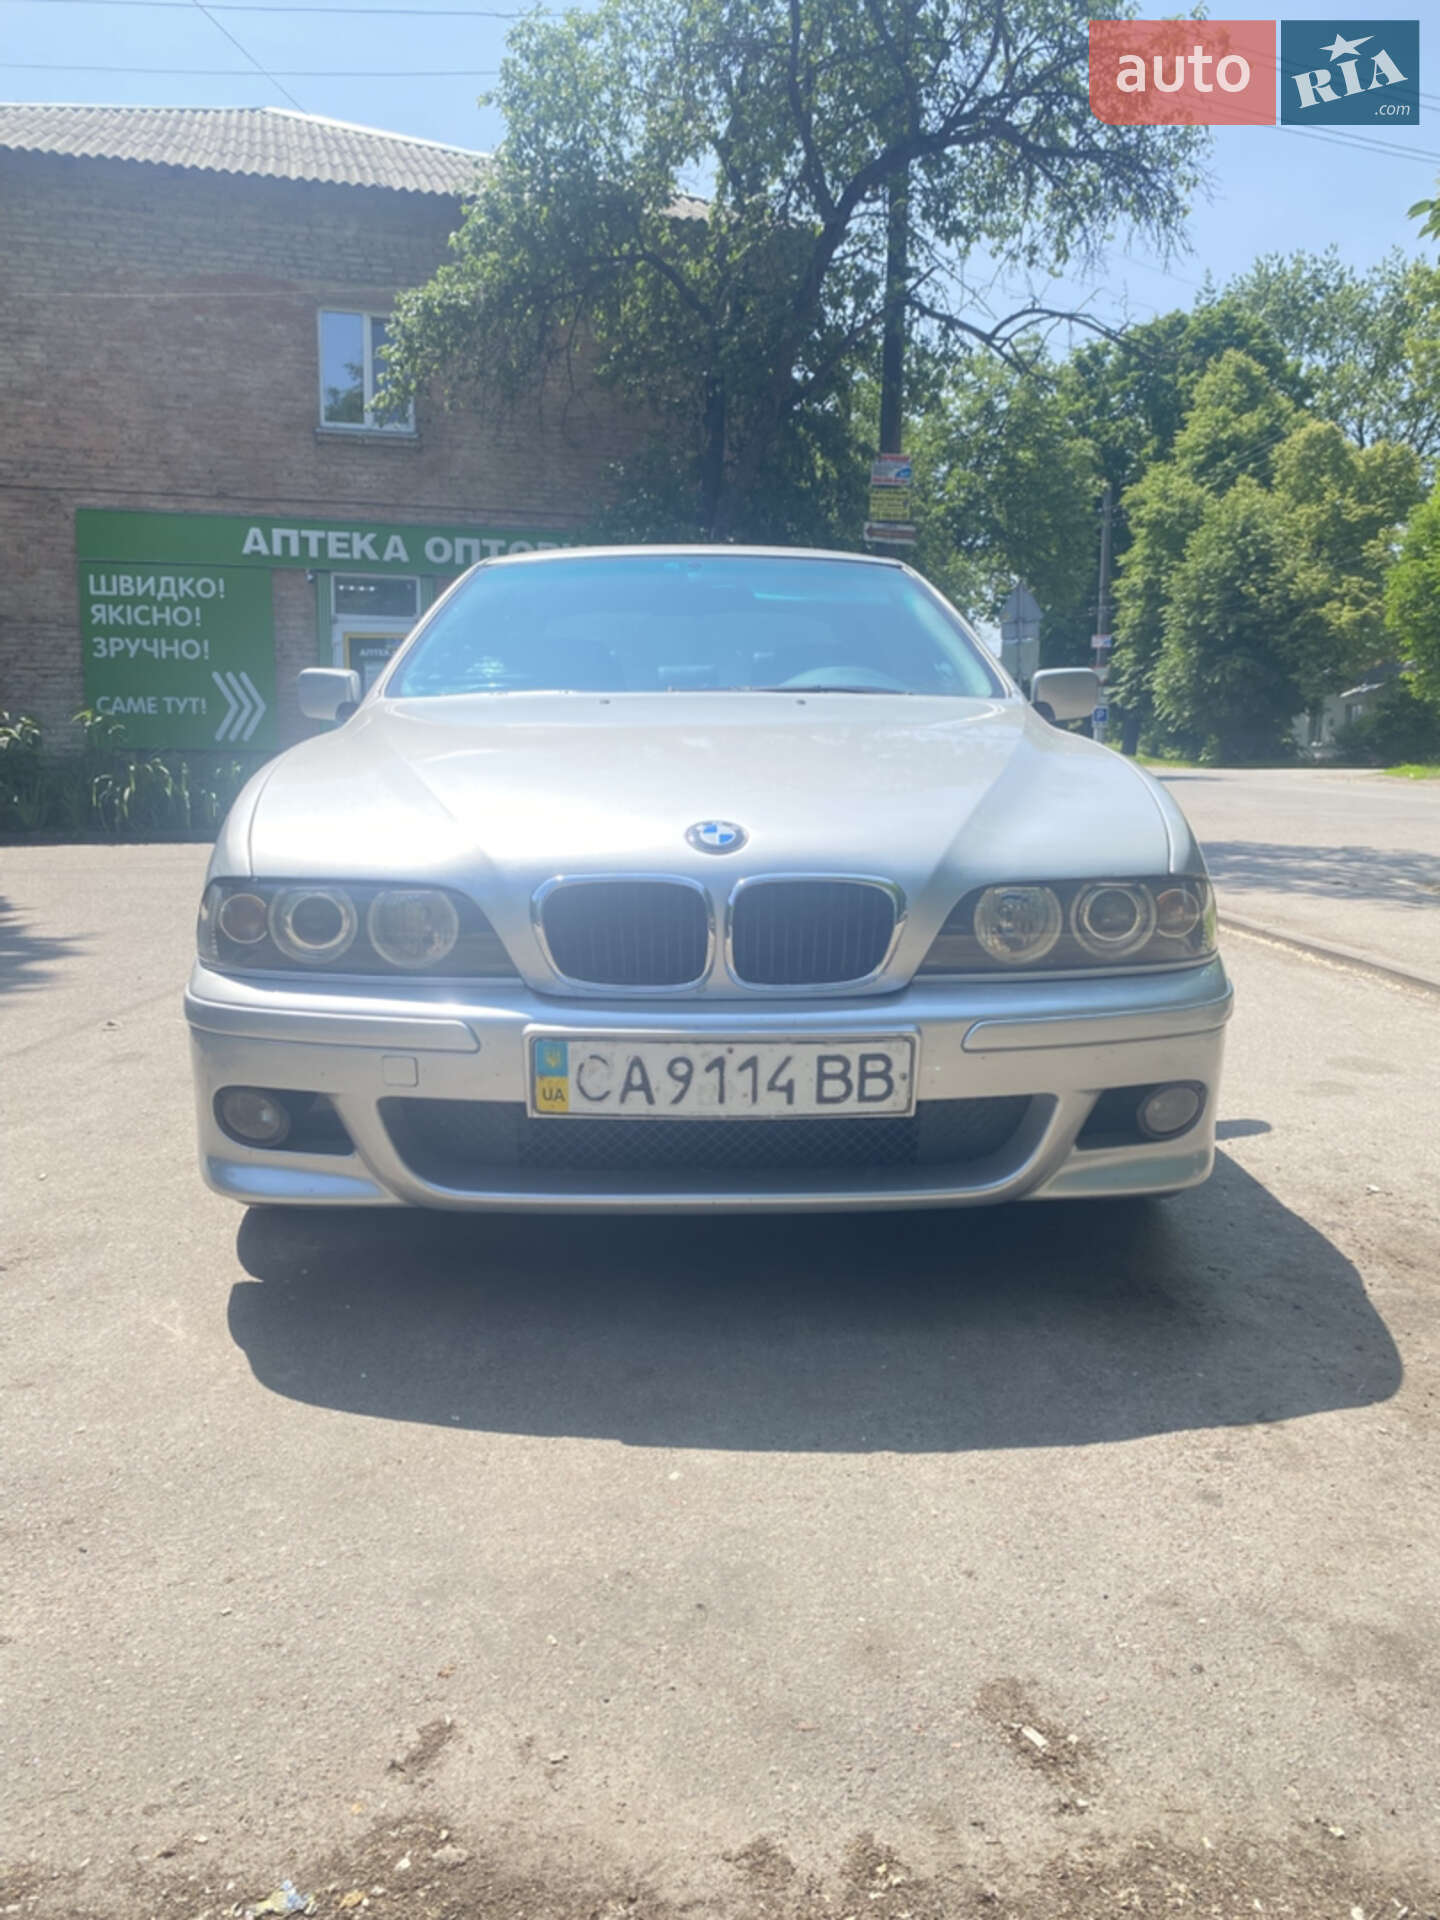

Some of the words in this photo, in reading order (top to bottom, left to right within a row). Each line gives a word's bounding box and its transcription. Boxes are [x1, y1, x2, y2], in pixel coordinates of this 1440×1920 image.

[242, 527, 410, 563] АПТЕКА
[88, 573, 226, 602] ШВИДКО!
[90, 603, 201, 627] ЯКІСНО!
[92, 637, 209, 661] ЗРУЧНО!
[96, 696, 160, 715] САМЕ
[161, 697, 208, 715] ТУТ!
[542, 1088, 566, 1102] UA
